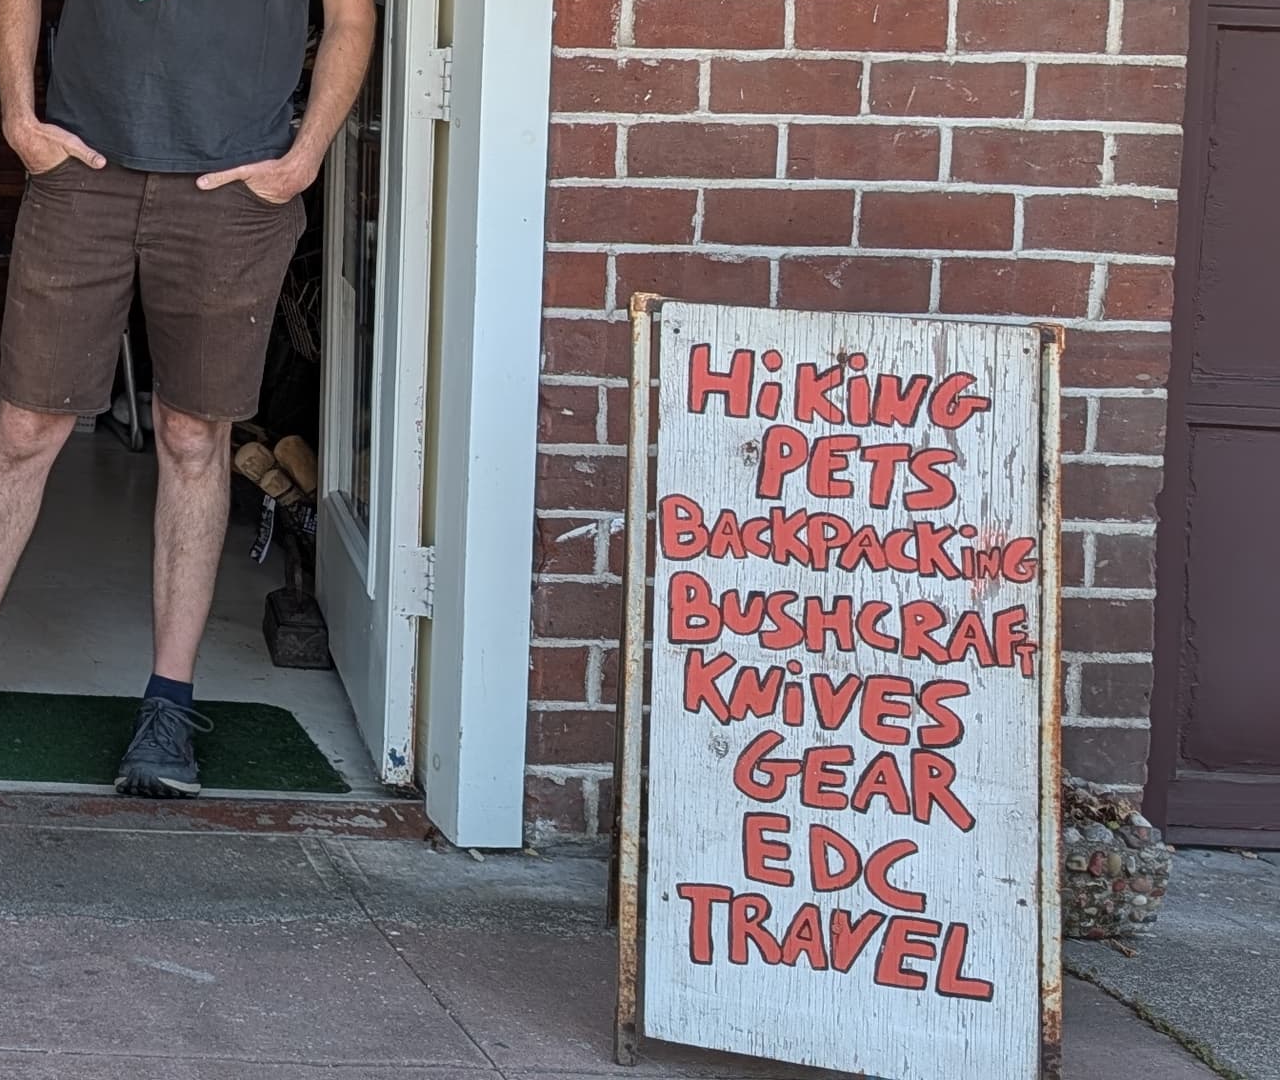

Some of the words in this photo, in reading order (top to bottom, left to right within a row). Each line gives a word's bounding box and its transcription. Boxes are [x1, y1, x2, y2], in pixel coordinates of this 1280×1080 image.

[758, 425, 957, 511] PETS
[667, 570, 1036, 678] BUSHCRAFT
[732, 729, 976, 831] GEAR
[743, 813, 926, 913] EDC
[677, 883, 993, 1002] TRAVEL
